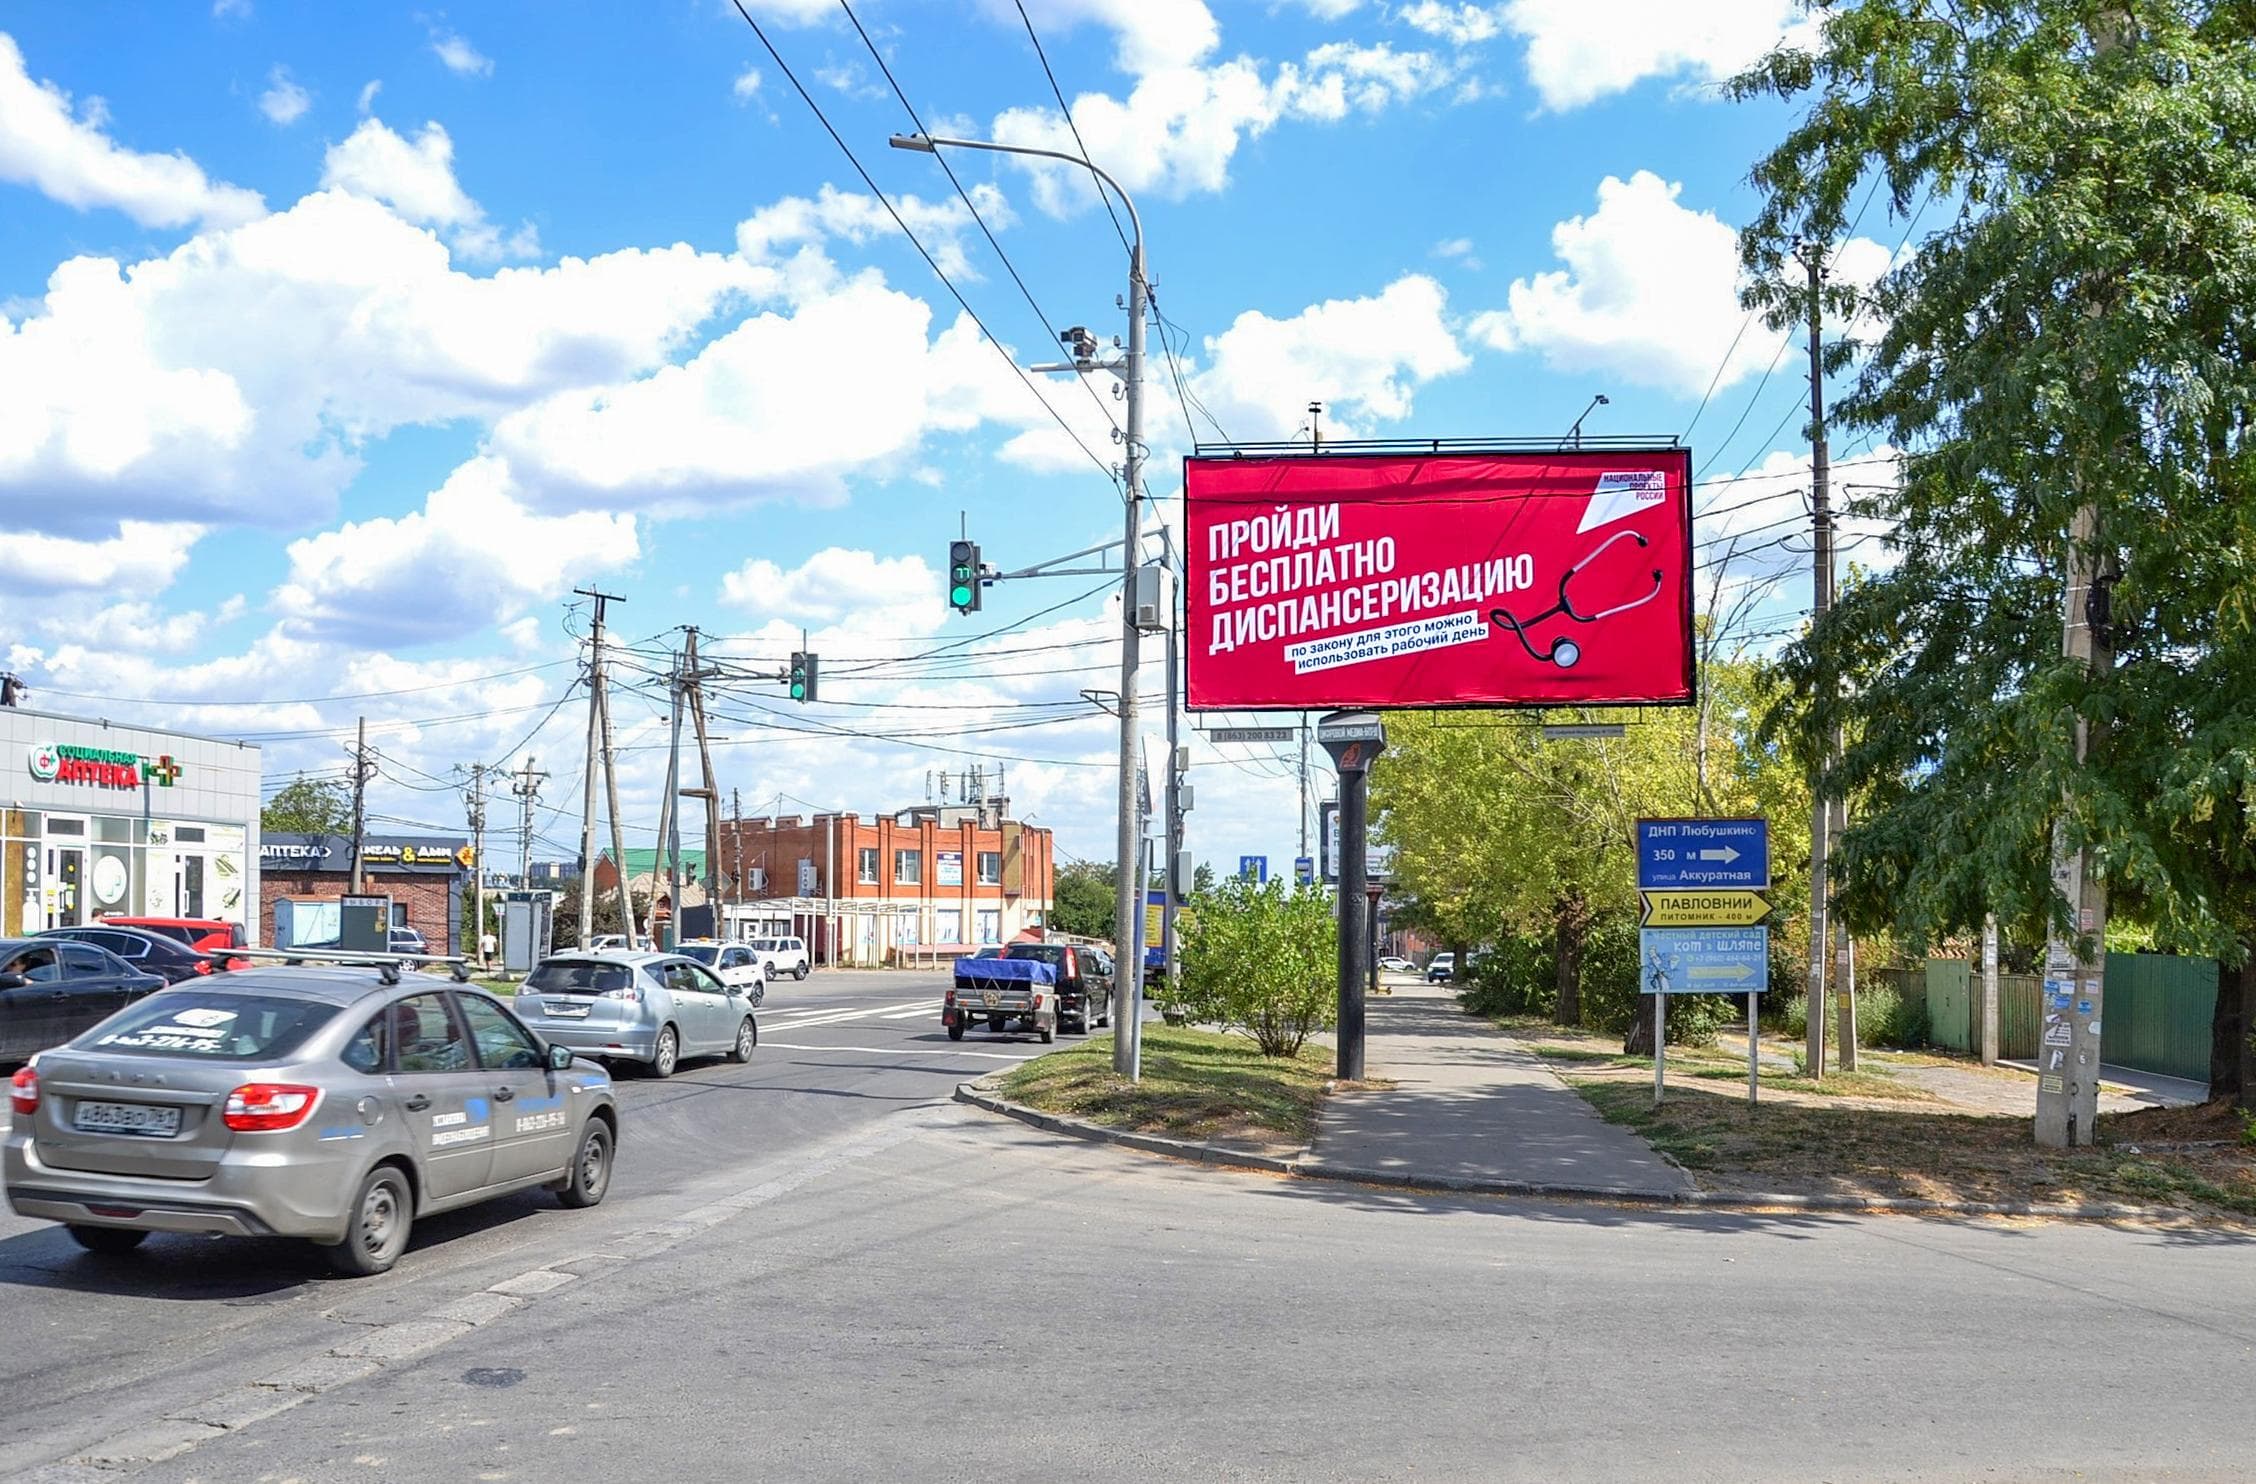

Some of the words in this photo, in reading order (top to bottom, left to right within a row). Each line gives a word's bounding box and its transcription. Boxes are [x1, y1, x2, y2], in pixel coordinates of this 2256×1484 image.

[1636, 492, 1663, 500] РОССИИ
[1209, 503, 1340, 561] ПРОЙДИ
[1209, 536, 1395, 606] БЕСПЛАТНО
[1209, 553, 1534, 656] ДИСПАНСЕРИЗАЦИЮ
[1291, 646, 1307, 657] по
[1310, 637, 1353, 654] закону
[1356, 631, 1381, 647] для
[1384, 624, 1421, 640] этого
[1424, 615, 1472, 632] можно
[1298, 644, 1388, 669] использовать
[1391, 631, 1449, 655] рабочий
[1452, 626, 1486, 643] день
[58, 745, 138, 764] СОЦИАЛЬНАЯ
[57, 758, 138, 787] АПТЕКА
[1648, 825, 1677, 838] ДНП
[1681, 824, 1757, 838] Любушкино
[259, 845, 320, 858] АПТЕКА
[1653, 849, 1676, 860] 350
[1686, 852, 1697, 860] м
[1652, 873, 1676, 881] улица
[1680, 870, 1751, 882] Аккуратная
[1660, 898, 1752, 910] ПАВЛОВНИИ
[1660, 912, 1715, 920] ПИТОМНИК
[1726, 912, 1741, 920] 400
[1743, 931, 1761, 941] сад
